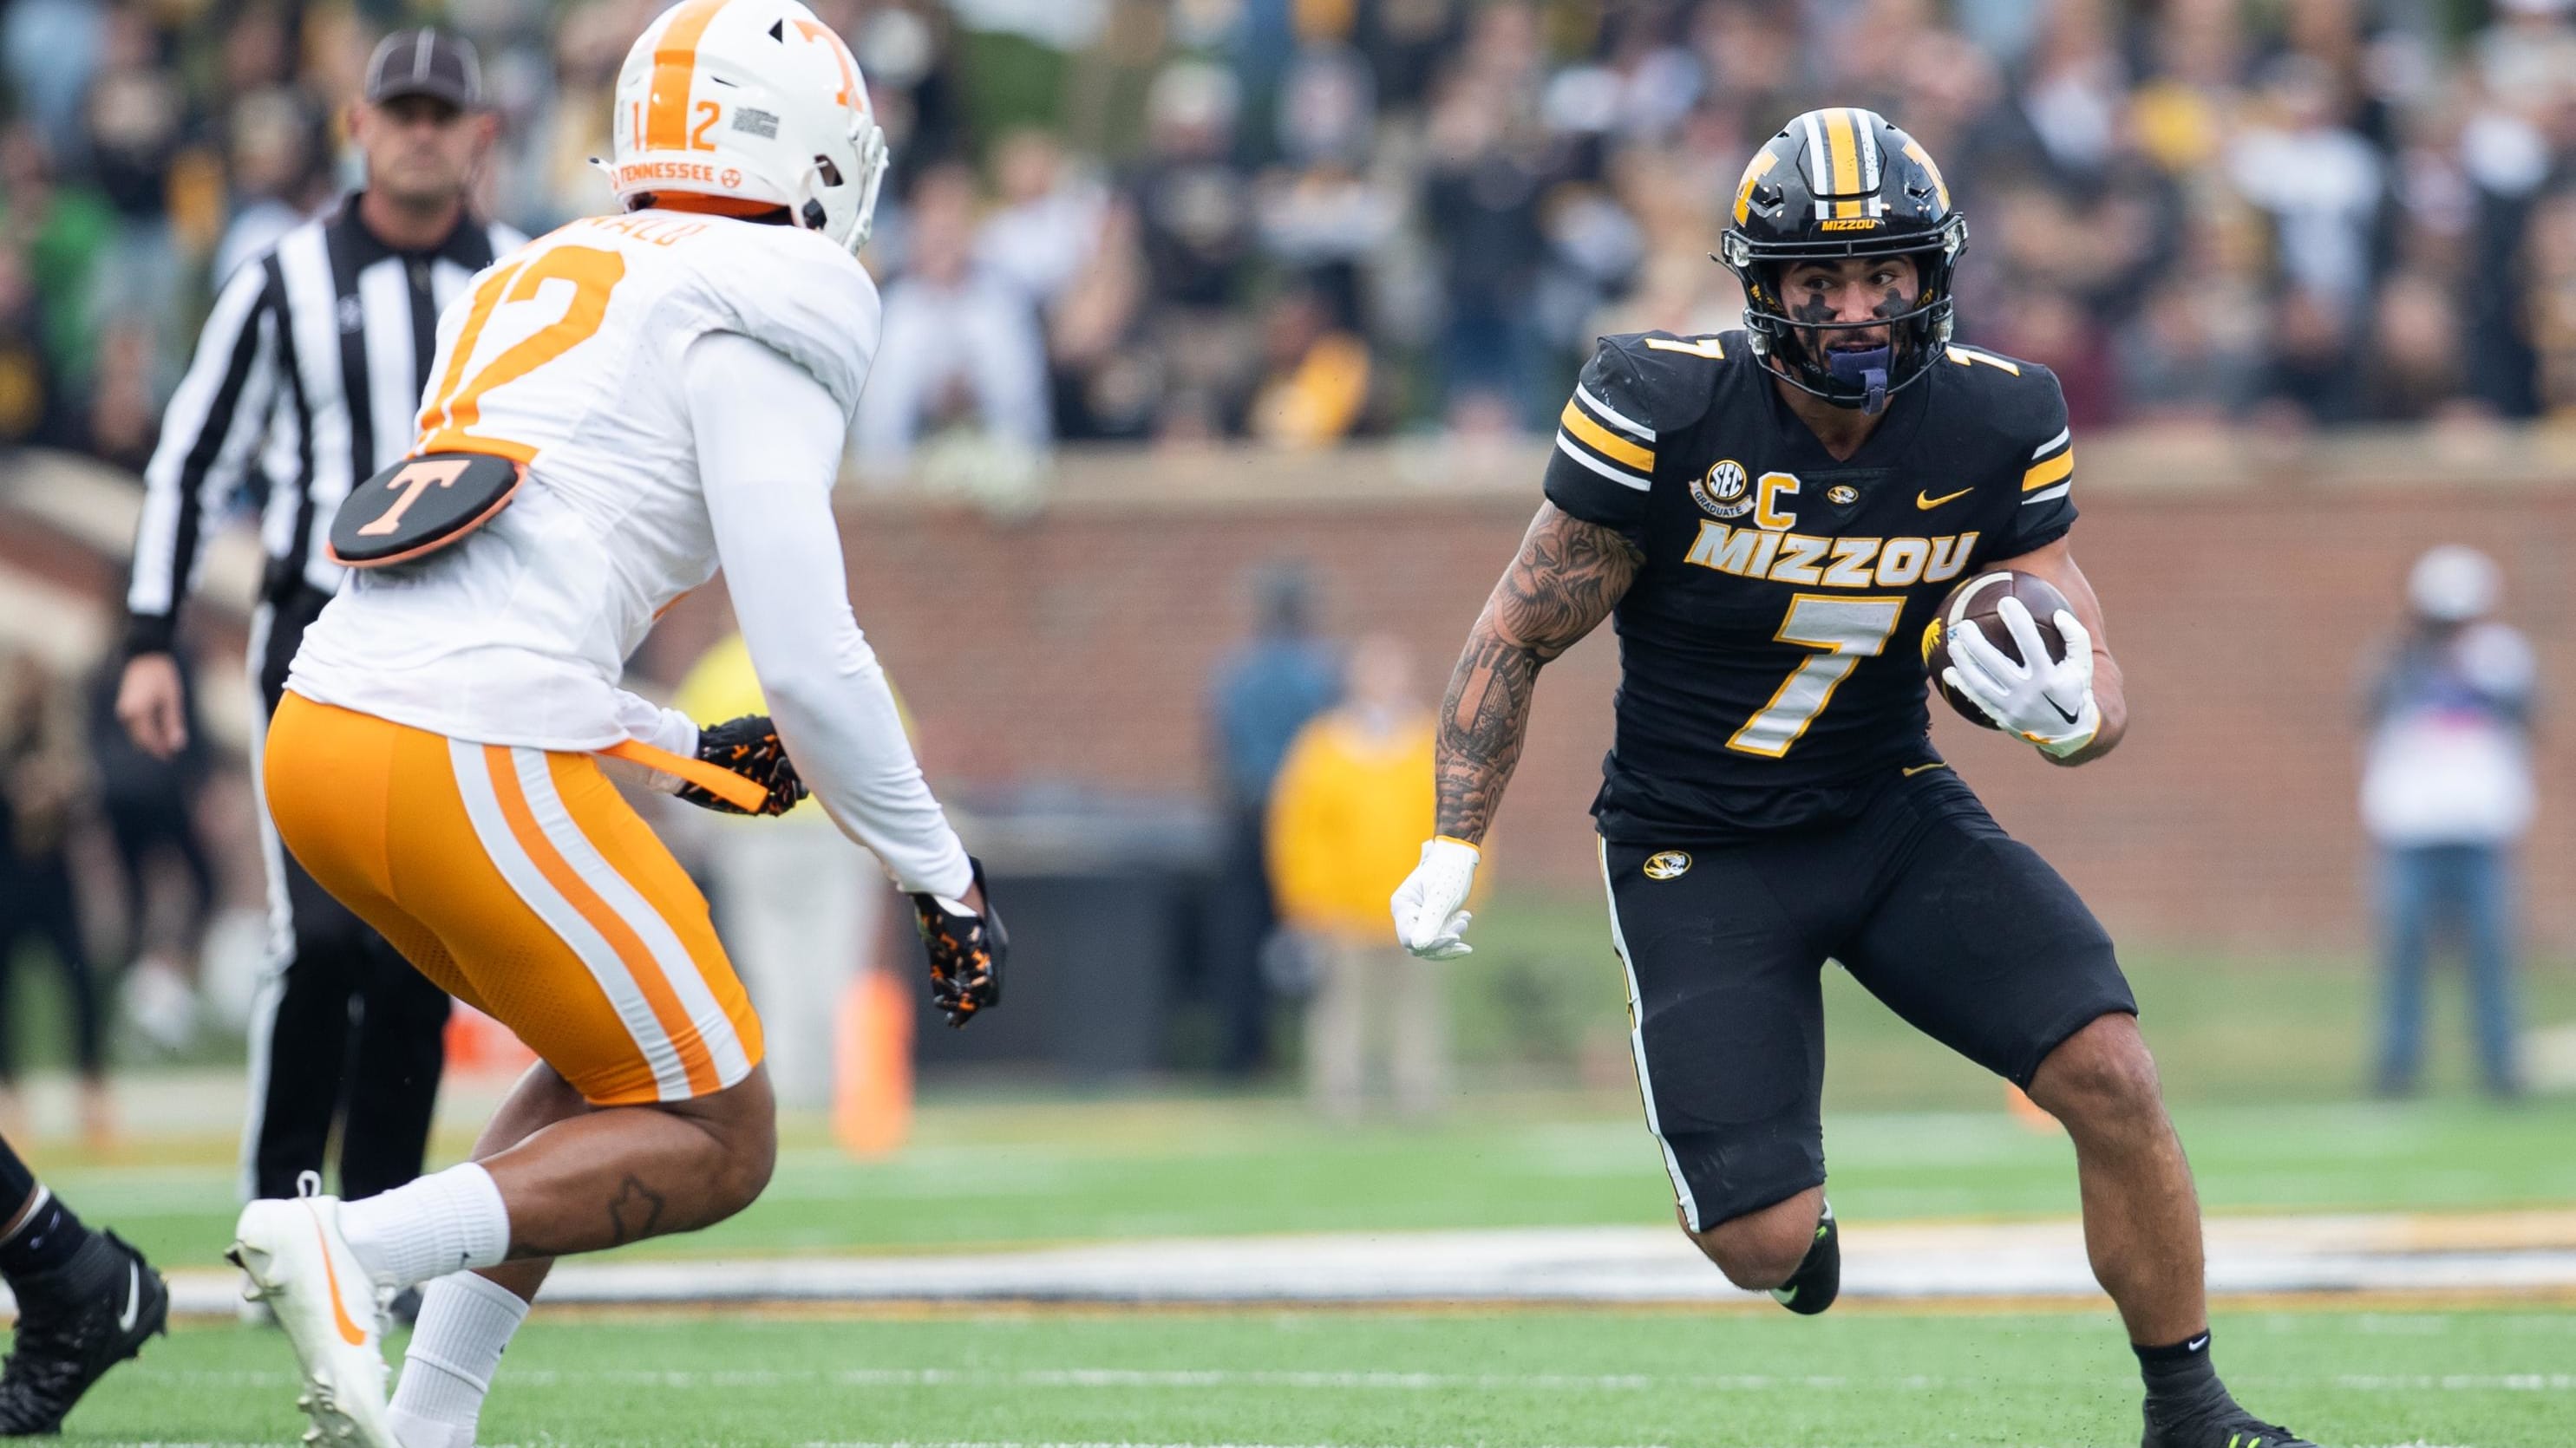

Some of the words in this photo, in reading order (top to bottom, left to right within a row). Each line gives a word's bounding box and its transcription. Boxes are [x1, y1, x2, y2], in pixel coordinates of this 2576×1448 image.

[620, 162, 714, 183] TENNESSEE
[1821, 219, 1876, 232] MIZZOU
[405, 245, 627, 466] 12
[356, 459, 472, 537] T
[1694, 490, 1742, 517] GRADUATE
[1709, 462, 1744, 498] SEC
[1753, 471, 1801, 532] C
[1683, 518, 1980, 588] MIZZOU
[1724, 591, 1908, 760] 7
